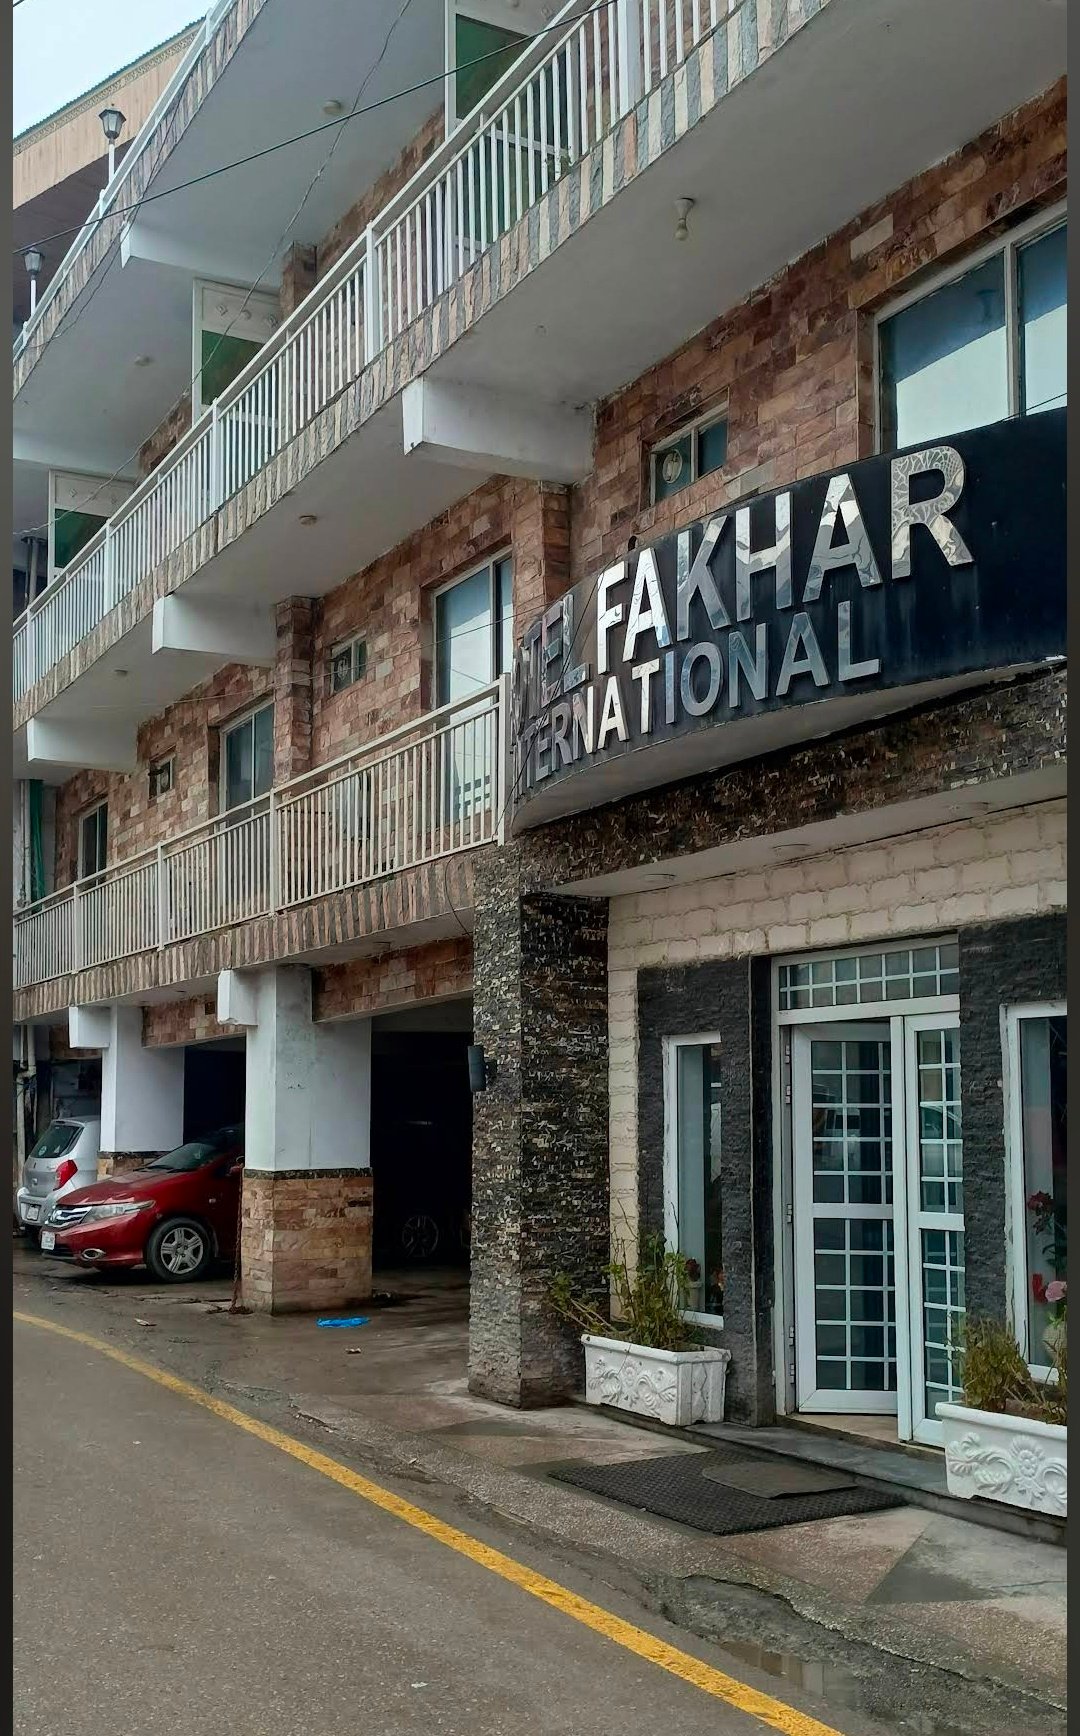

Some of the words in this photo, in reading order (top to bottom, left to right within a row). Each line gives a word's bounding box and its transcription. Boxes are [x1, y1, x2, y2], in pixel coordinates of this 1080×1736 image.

[510, 594, 590, 745] OTEL
[597, 446, 974, 675] FAKHAR
[513, 601, 881, 802] TERNATIONAL
